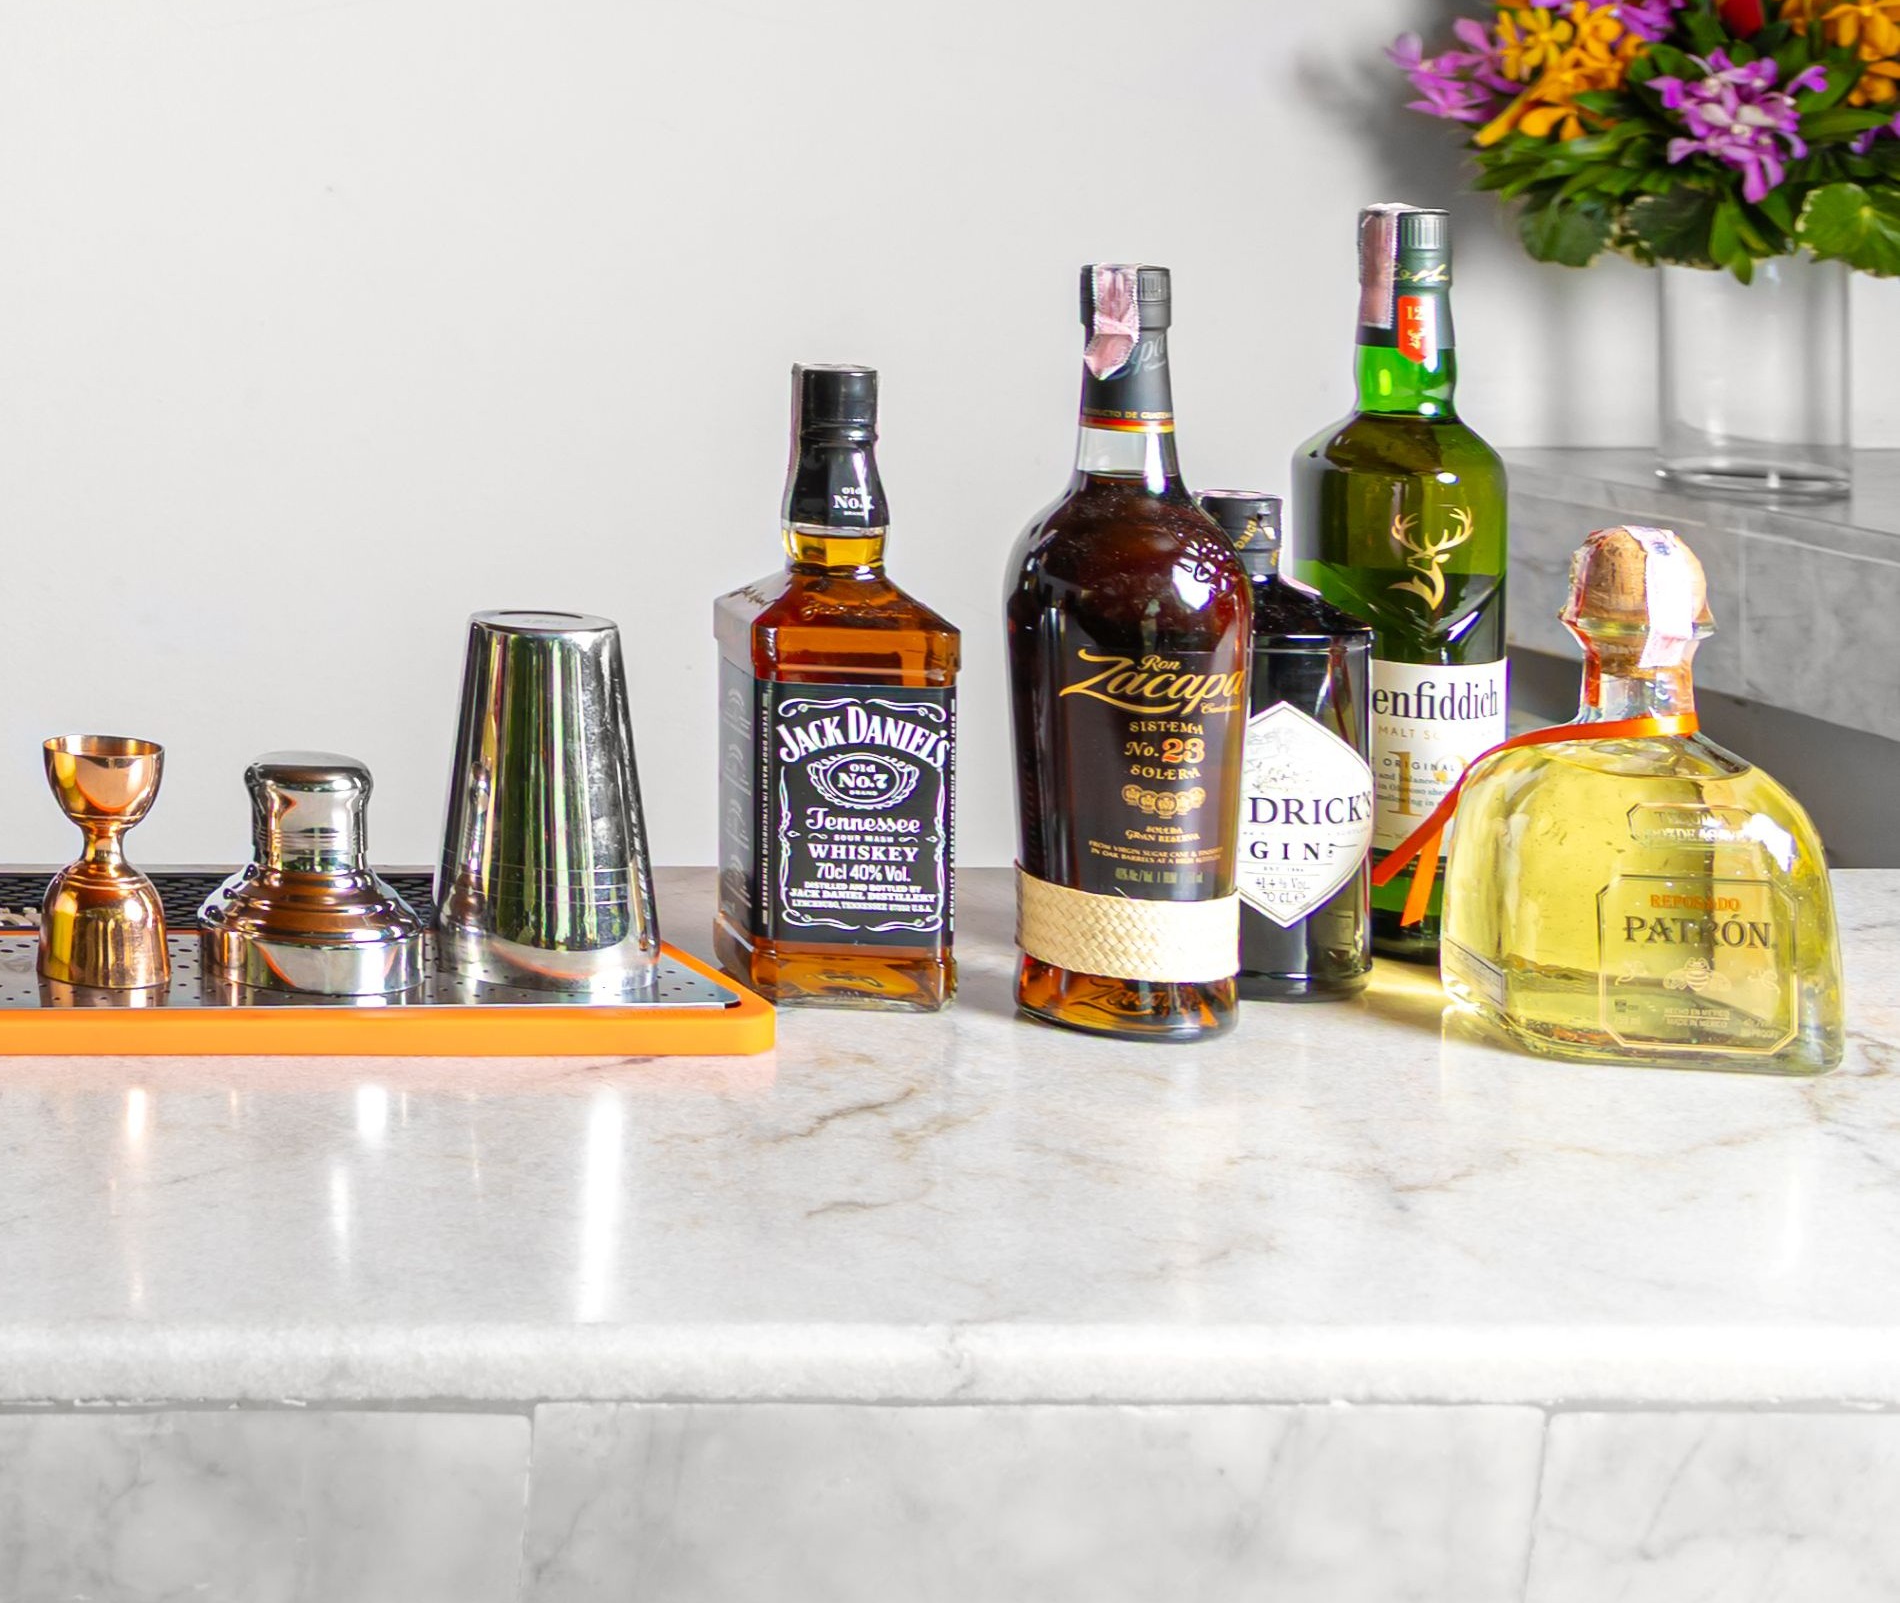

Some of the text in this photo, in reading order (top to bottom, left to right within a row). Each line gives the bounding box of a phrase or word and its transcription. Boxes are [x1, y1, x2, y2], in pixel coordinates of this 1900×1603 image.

[1406, 306, 1423, 320] 12
[1137, 654, 1181, 672] Ron
[1059, 648, 1245, 716] Zacapa
[1371, 679, 1498, 720] enfiddich
[776, 706, 950, 768] JACK DANIEL'S
[1129, 721, 1205, 735] SISTEMA
[1378, 726, 1415, 739] MALT
[761, 740, 769, 764] DROP
[1124, 737, 1206, 764] No. 23
[850, 763, 876, 773] Old
[1130, 764, 1202, 780] SOLERA
[1383, 758, 1455, 771] ORIGINAL
[761, 766, 769, 790] MADE
[837, 772, 889, 789] No.7
[761, 803, 769, 855] LYNCHBURG
[805, 807, 921, 833] Tennessee
[834, 834, 894, 843] SOUR MASH
[807, 843, 919, 862] WHISKEY
[1088, 839, 1111, 850] FROM
[1143, 849, 1168, 857] SUGAR
[1102, 850, 1119, 859] OAK
[1249, 840, 1320, 860] GIN
[815, 862, 911, 882] 70cl 40% Vol.
[761, 857, 769, 907] TENNESSEE
[804, 881, 848, 890] DISTILLED
[849, 882, 867, 891] AND
[869, 884, 908, 893] BOTTLED
[789, 888, 936, 903] JACK DANIEL DISTILLERY
[1650, 894, 1742, 911] REPOSADO
[1623, 913, 1771, 949] PATRÓN
